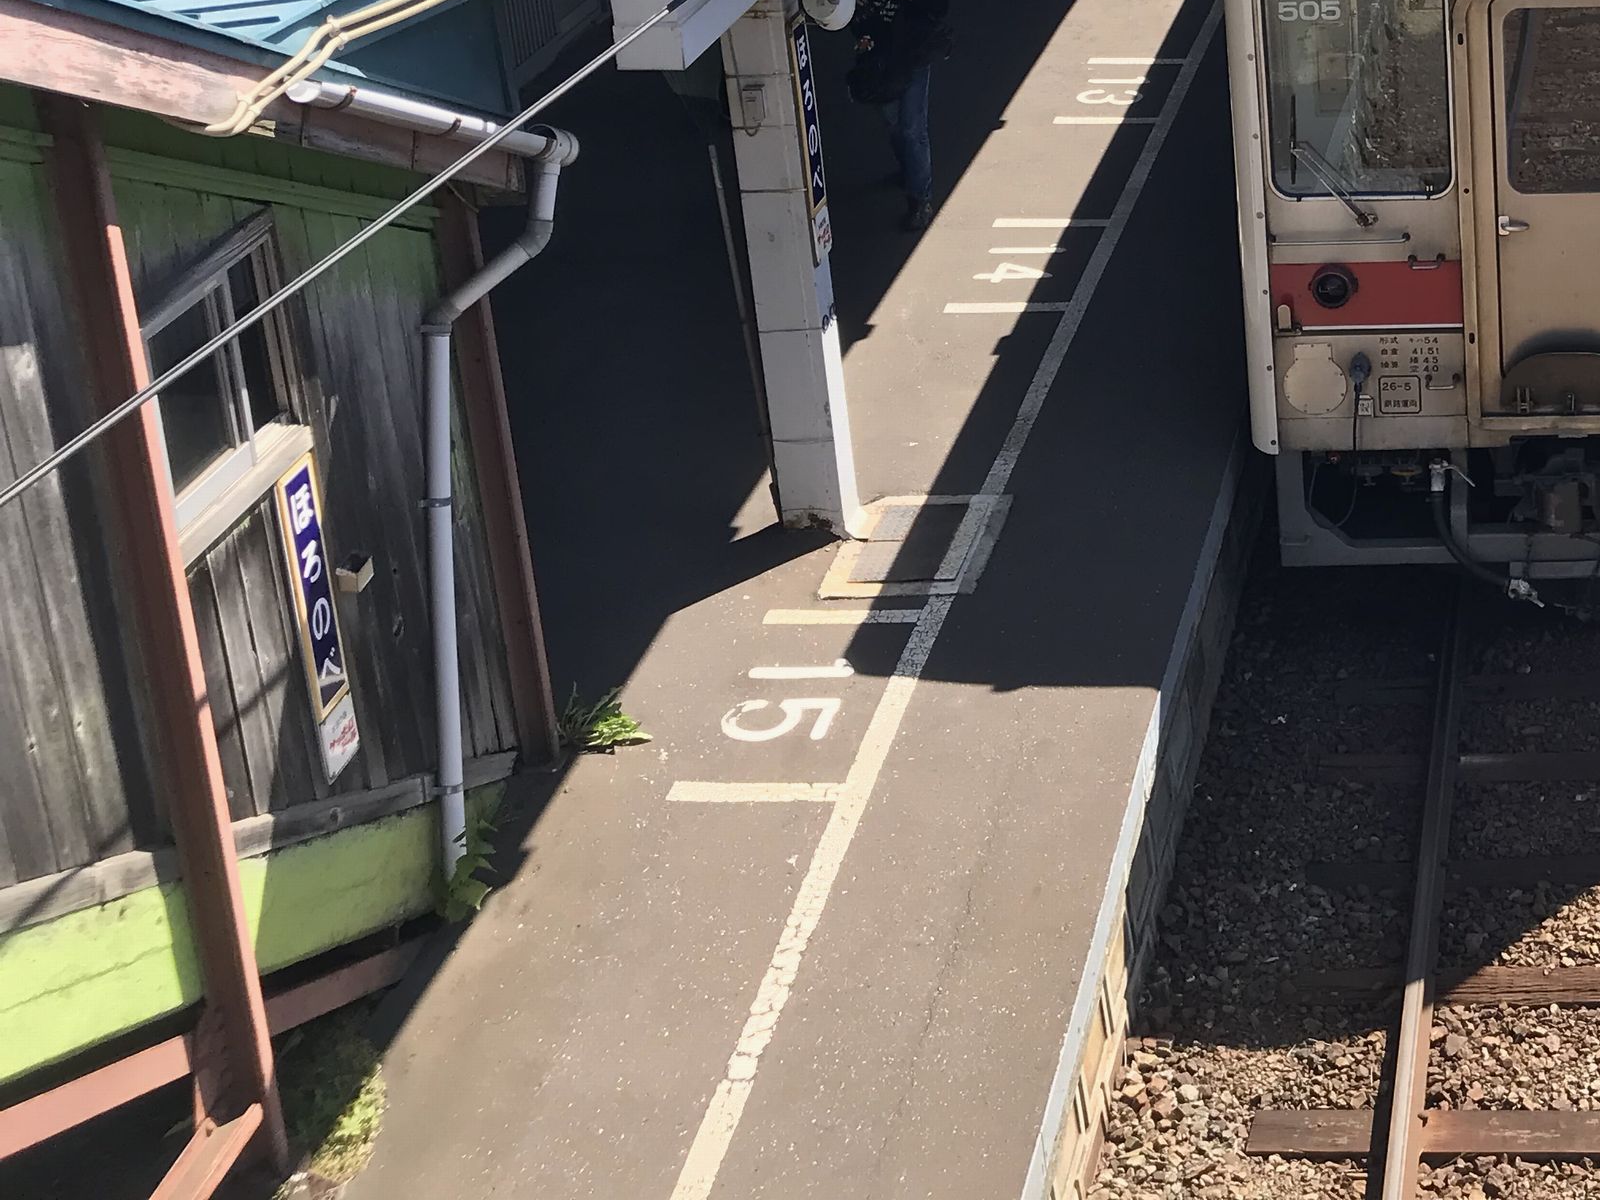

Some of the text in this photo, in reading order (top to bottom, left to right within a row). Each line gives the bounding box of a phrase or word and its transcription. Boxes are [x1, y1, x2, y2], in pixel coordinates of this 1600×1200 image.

[1278, 1, 1341, 22] 505
[1076, 76, 1150, 106] 13
[796, 34, 823, 189] ほろのべ
[972, 243, 1067, 283] 14
[1382, 382, 1412, 391] 26-5
[290, 482, 342, 680] ほろのべ
[720, 658, 855, 742] 15
